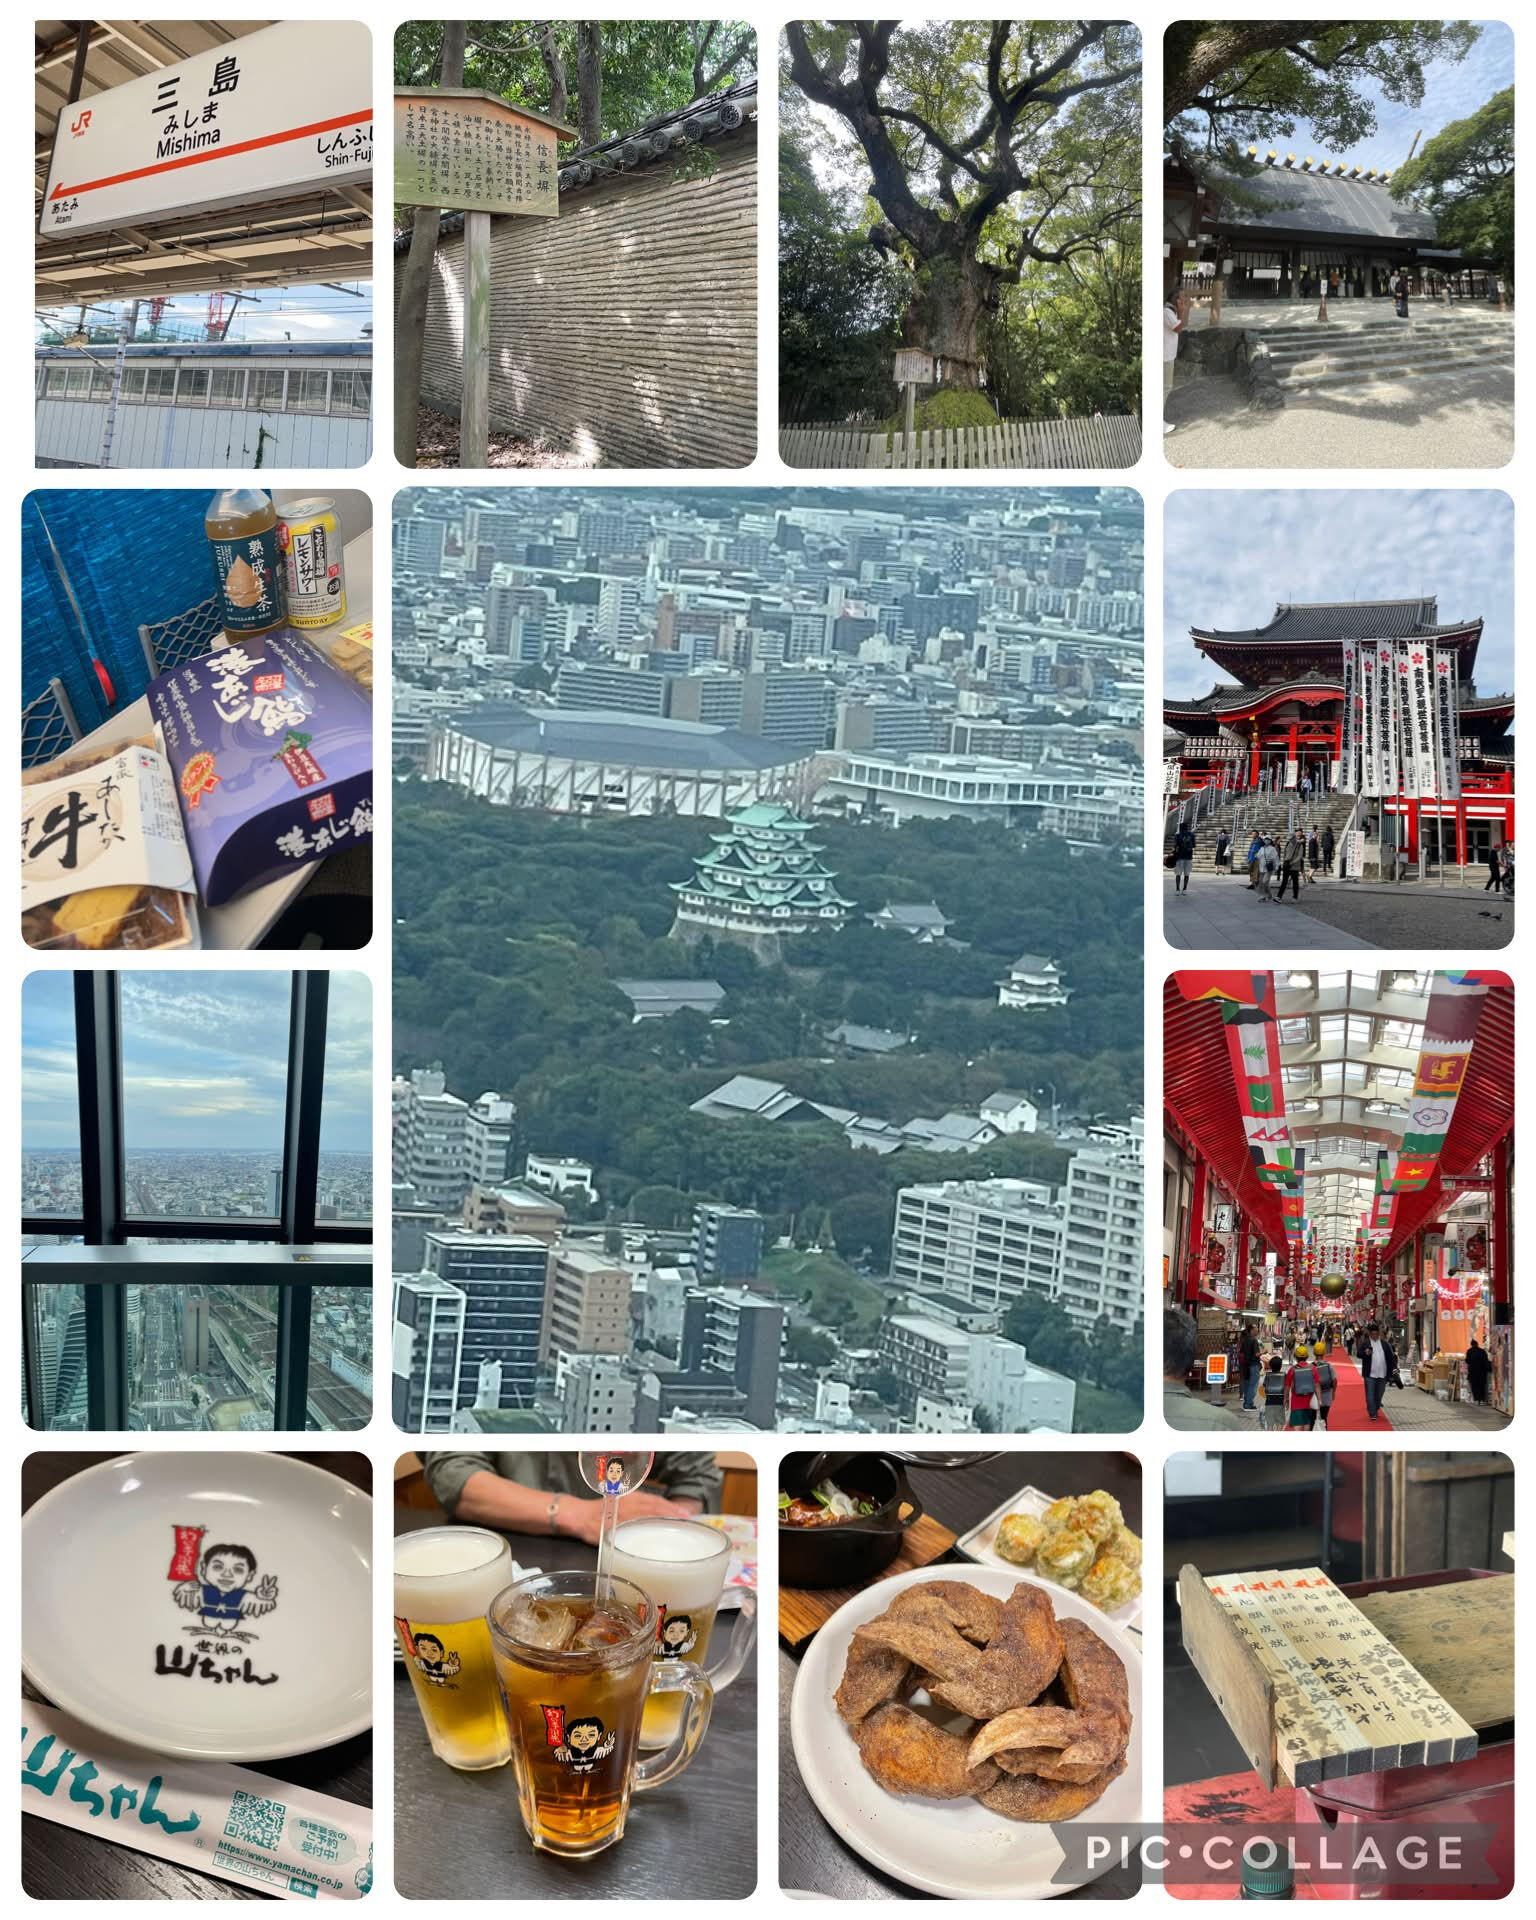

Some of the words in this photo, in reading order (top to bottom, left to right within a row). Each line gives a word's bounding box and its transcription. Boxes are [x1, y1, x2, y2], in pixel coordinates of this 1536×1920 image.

[152, 56, 240, 114] 三島
[71, 110, 92, 132] JR
[164, 101, 218, 135] みしま
[156, 129, 220, 159] Mishima
[536, 144, 549, 192] 信長塀
[51, 198, 79, 215] あたみ
[55, 213, 72, 224] Atami
[248, 539, 272, 612] 熟成生茶
[297, 535, 313, 593] レモンサワー
[29, 791, 98, 869] 牛
[155, 1643, 279, 1686] 山ちゃん
[21, 1726, 201, 1834] 山ちゃん
[300, 1819, 348, 1841] 各種宴会の
[306, 1831, 338, 1849] ご予約
[218, 1840, 344, 1890] https://www.yamachan.co.jp
[302, 1840, 339, 1861] 受付中!
[216, 1855, 274, 1882] 世界の山ちゃん
